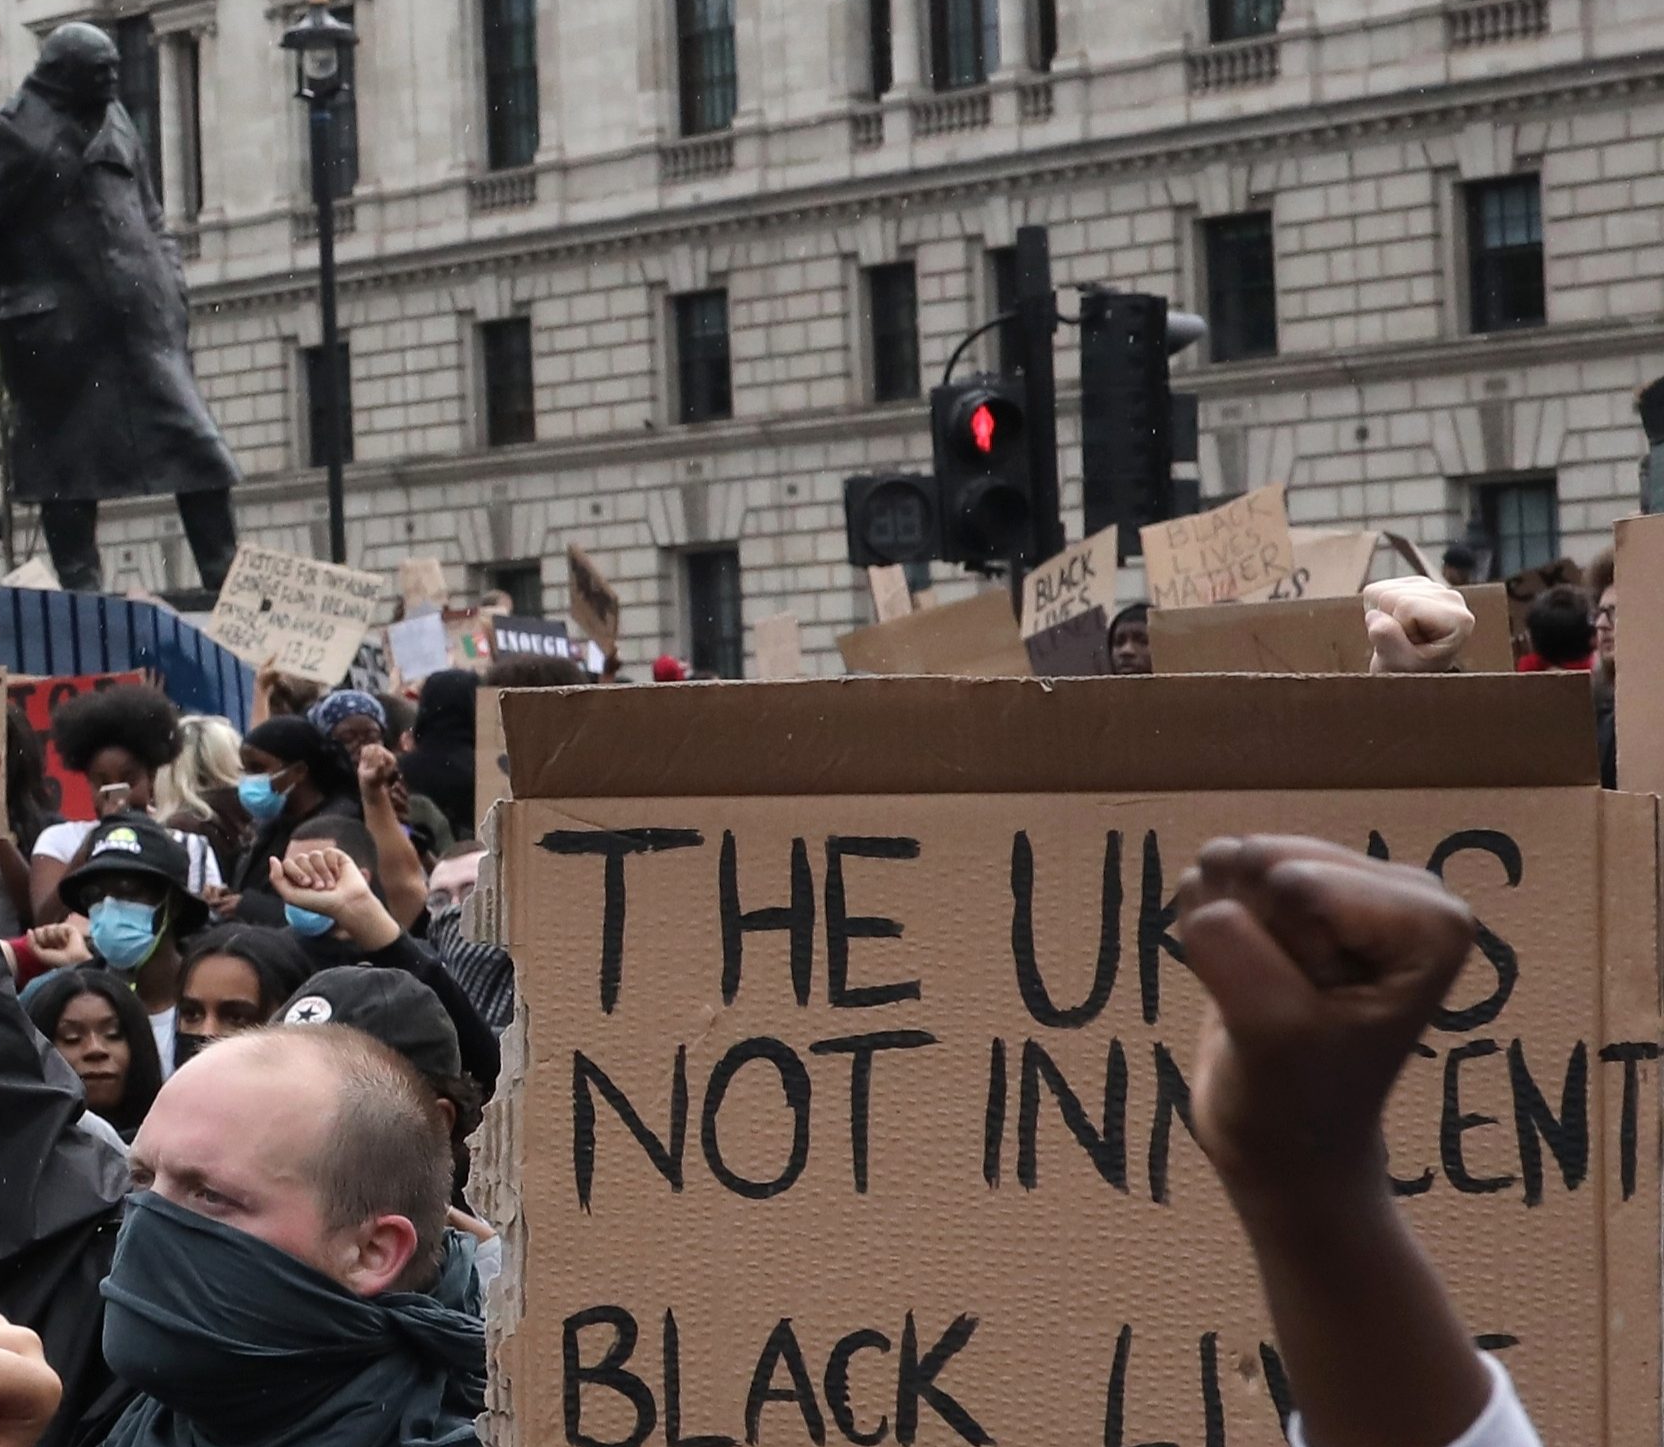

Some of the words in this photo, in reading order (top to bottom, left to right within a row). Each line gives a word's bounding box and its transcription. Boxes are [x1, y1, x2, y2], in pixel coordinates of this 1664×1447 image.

[1166, 494, 1272, 550] BLACK
[1174, 529, 1261, 574] LIVES
[1035, 550, 1096, 612] BLACK
[1154, 542, 1291, 607] MATTER
[496, 628, 570, 658] ENOUGH
[536, 826, 922, 1014] THE
[1362, 827, 1527, 1035] S
[570, 1029, 940, 1217] NOT
